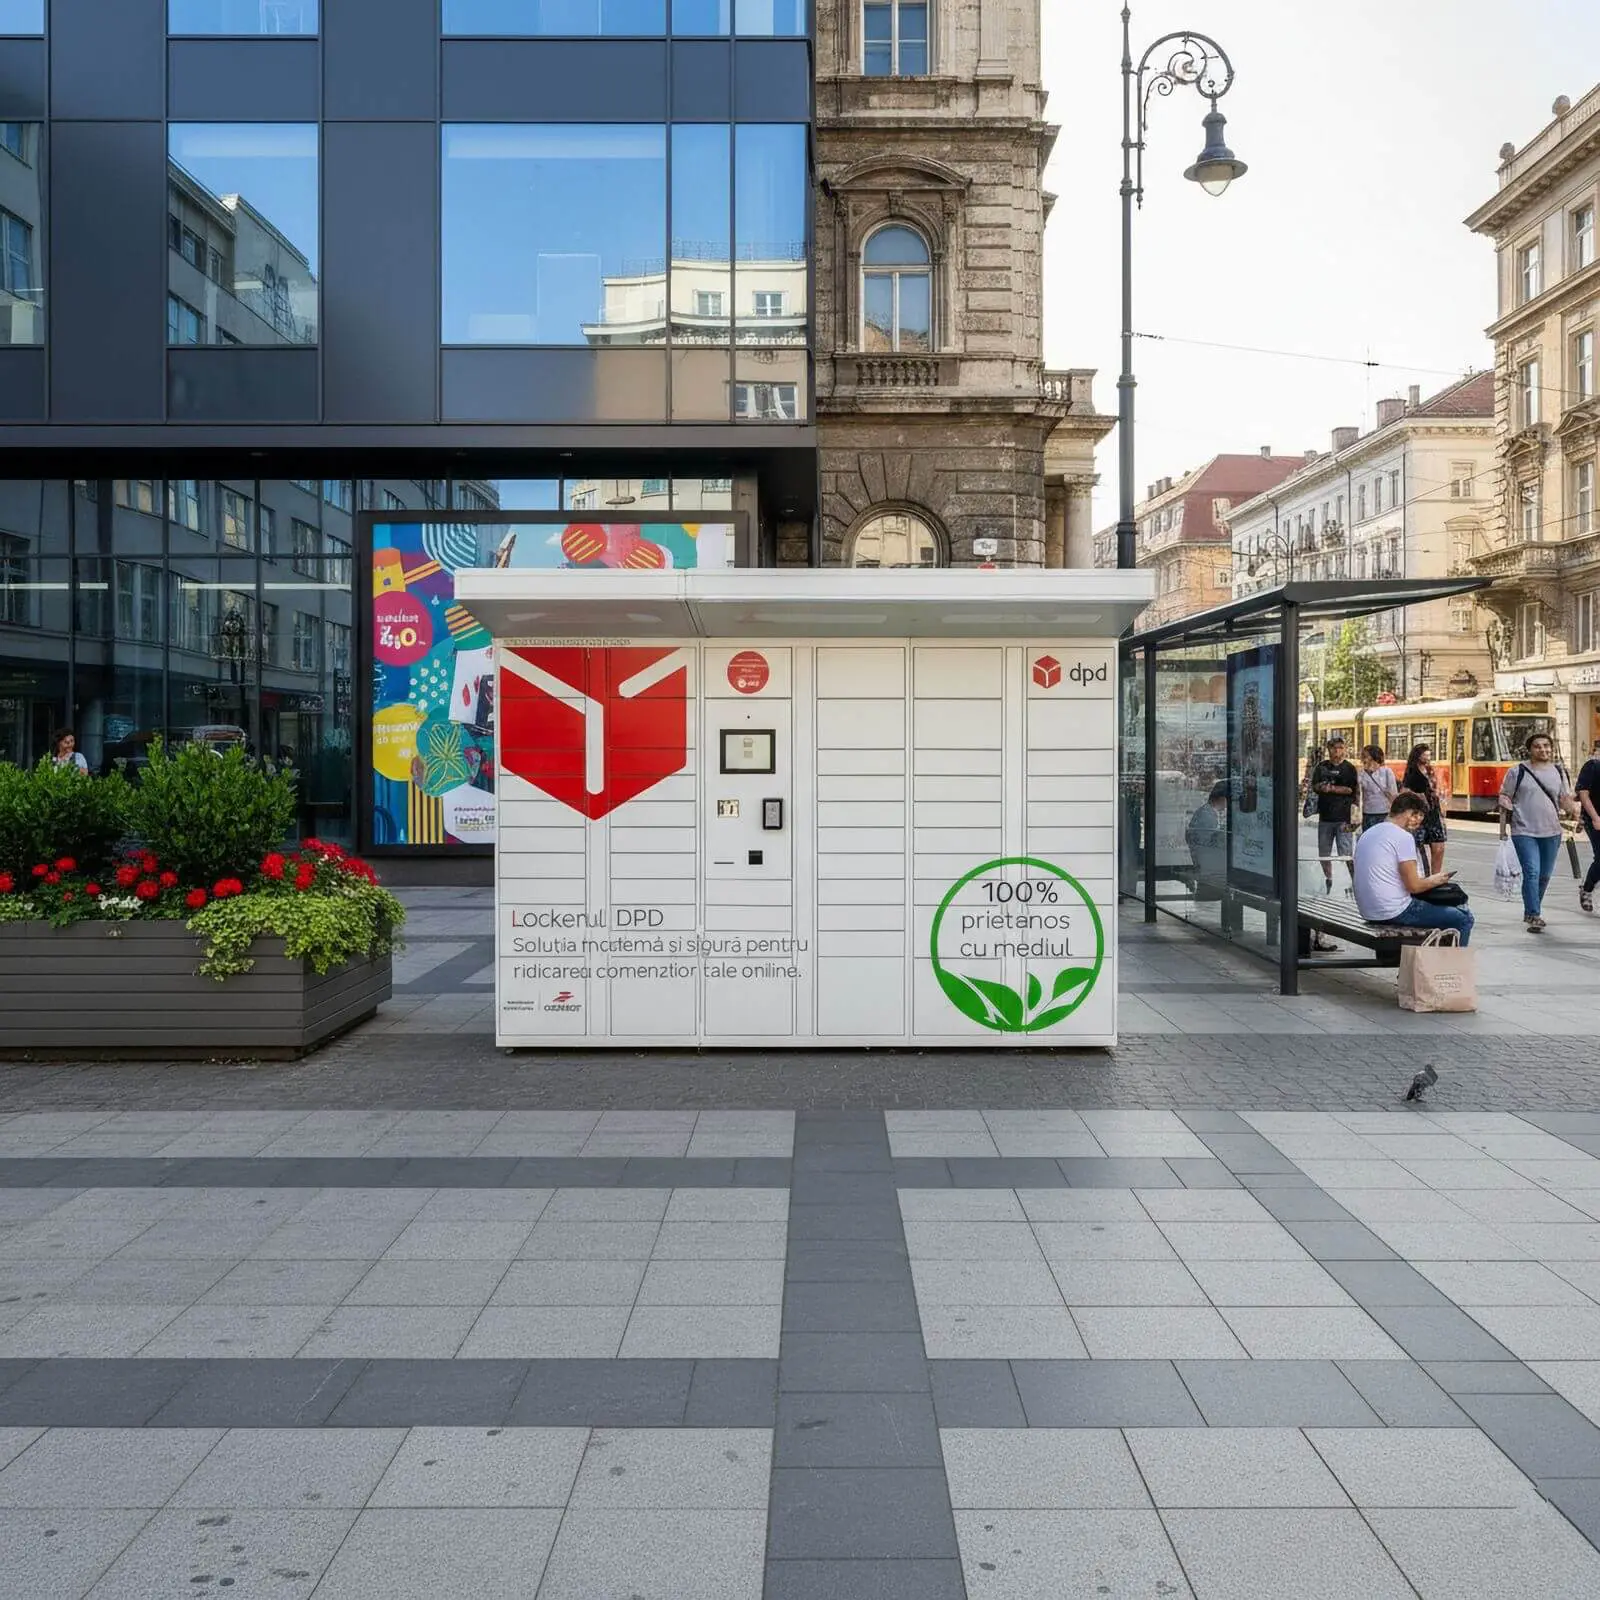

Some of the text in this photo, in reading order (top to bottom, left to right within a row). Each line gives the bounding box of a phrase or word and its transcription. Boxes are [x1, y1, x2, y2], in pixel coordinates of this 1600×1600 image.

[1070, 662, 1107, 687] dpd
[981, 881, 1058, 903] 100%
[616, 909, 664, 927] DPD
[747, 937, 808, 956] pentru
[960, 937, 1073, 957] cu mediul
